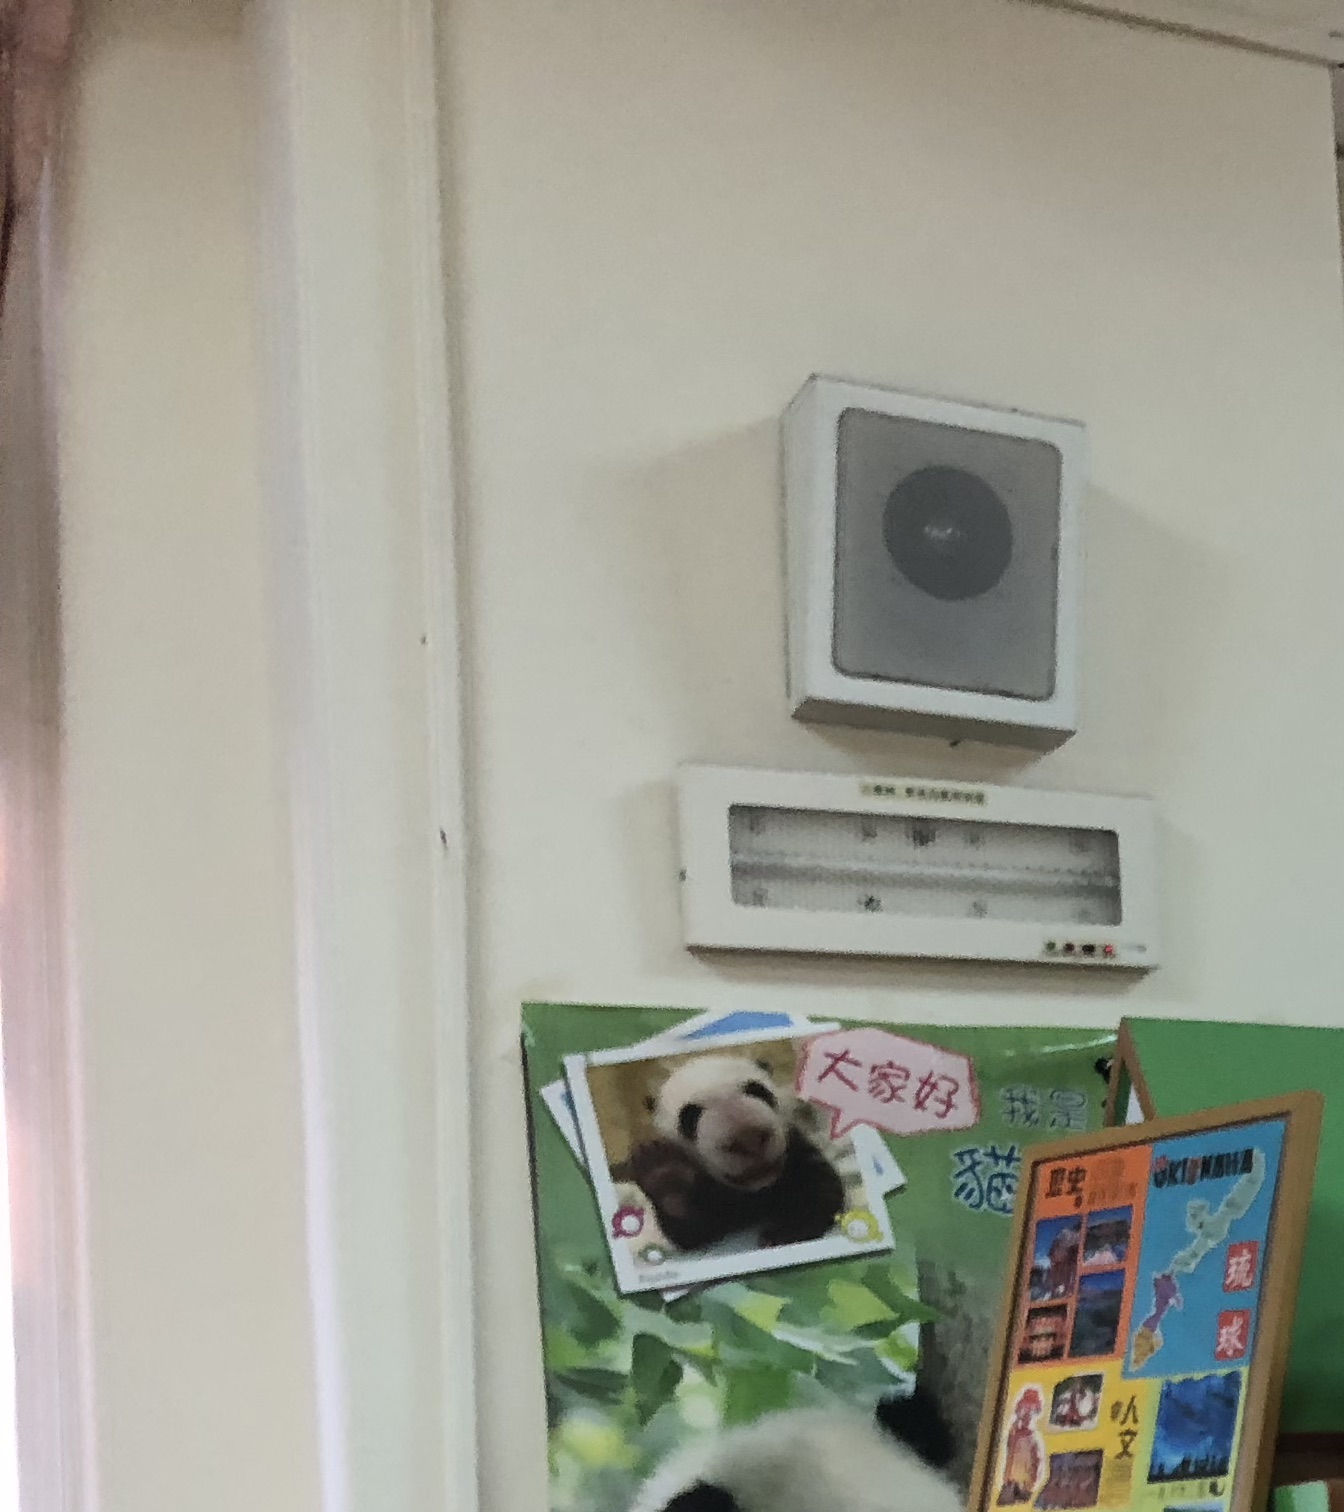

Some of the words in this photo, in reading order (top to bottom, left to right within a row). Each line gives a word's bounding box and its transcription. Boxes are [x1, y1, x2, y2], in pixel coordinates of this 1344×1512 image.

[817, 1048, 960, 1120] 大家好
[1001, 1086, 1088, 1130] 我是
